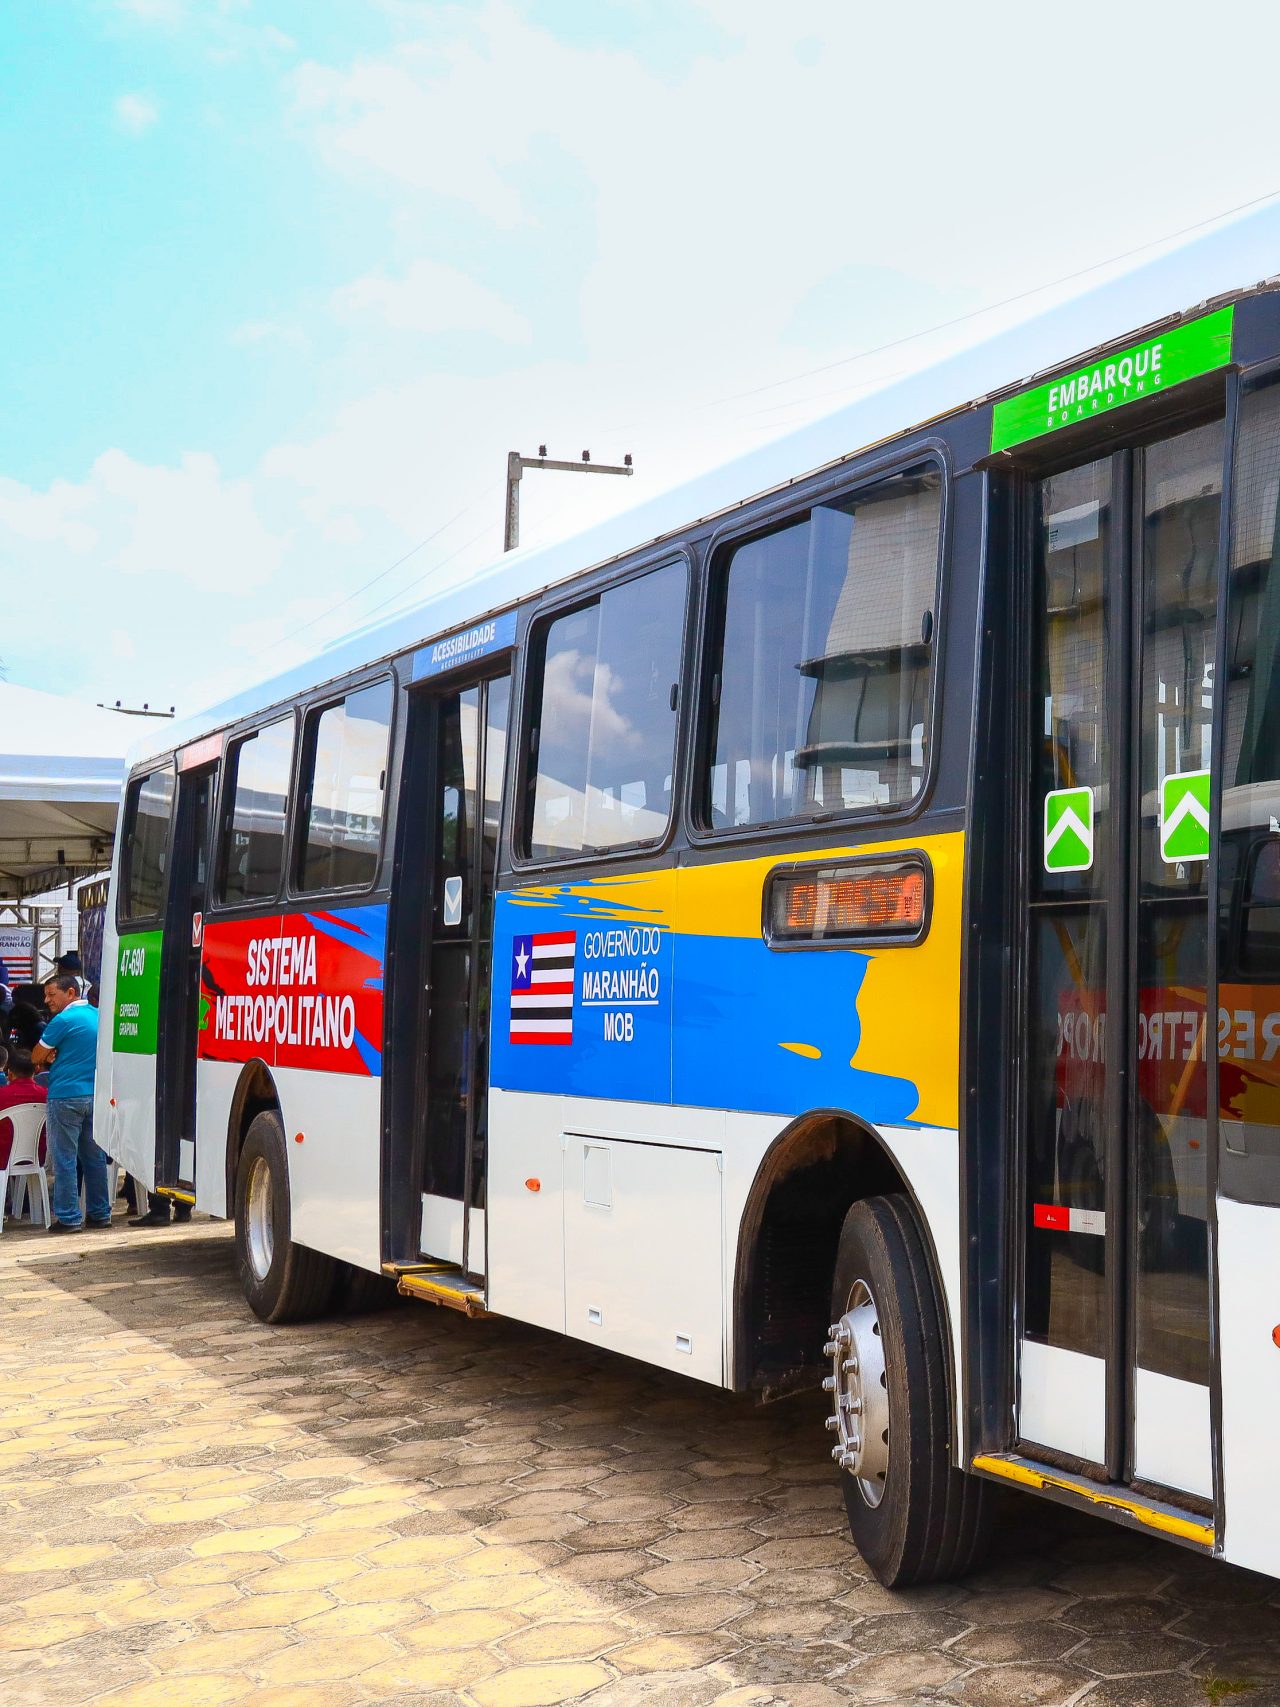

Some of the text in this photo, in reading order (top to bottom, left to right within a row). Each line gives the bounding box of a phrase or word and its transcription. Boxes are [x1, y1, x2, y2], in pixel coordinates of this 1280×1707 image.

[1048, 343, 1163, 413] EMBARQUE
[1047, 373, 1161, 427] BOARDING
[431, 622, 496, 664] ACESSIBILIDADE
[120, 947, 145, 977] 47-690
[246, 935, 317, 987] SISTEMA
[584, 926, 661, 960] GOVERNO DO
[582, 961, 659, 1000] MARANHÃO
[215, 994, 357, 1050] METROPOLITANO
[603, 1011, 635, 1042] MOB
